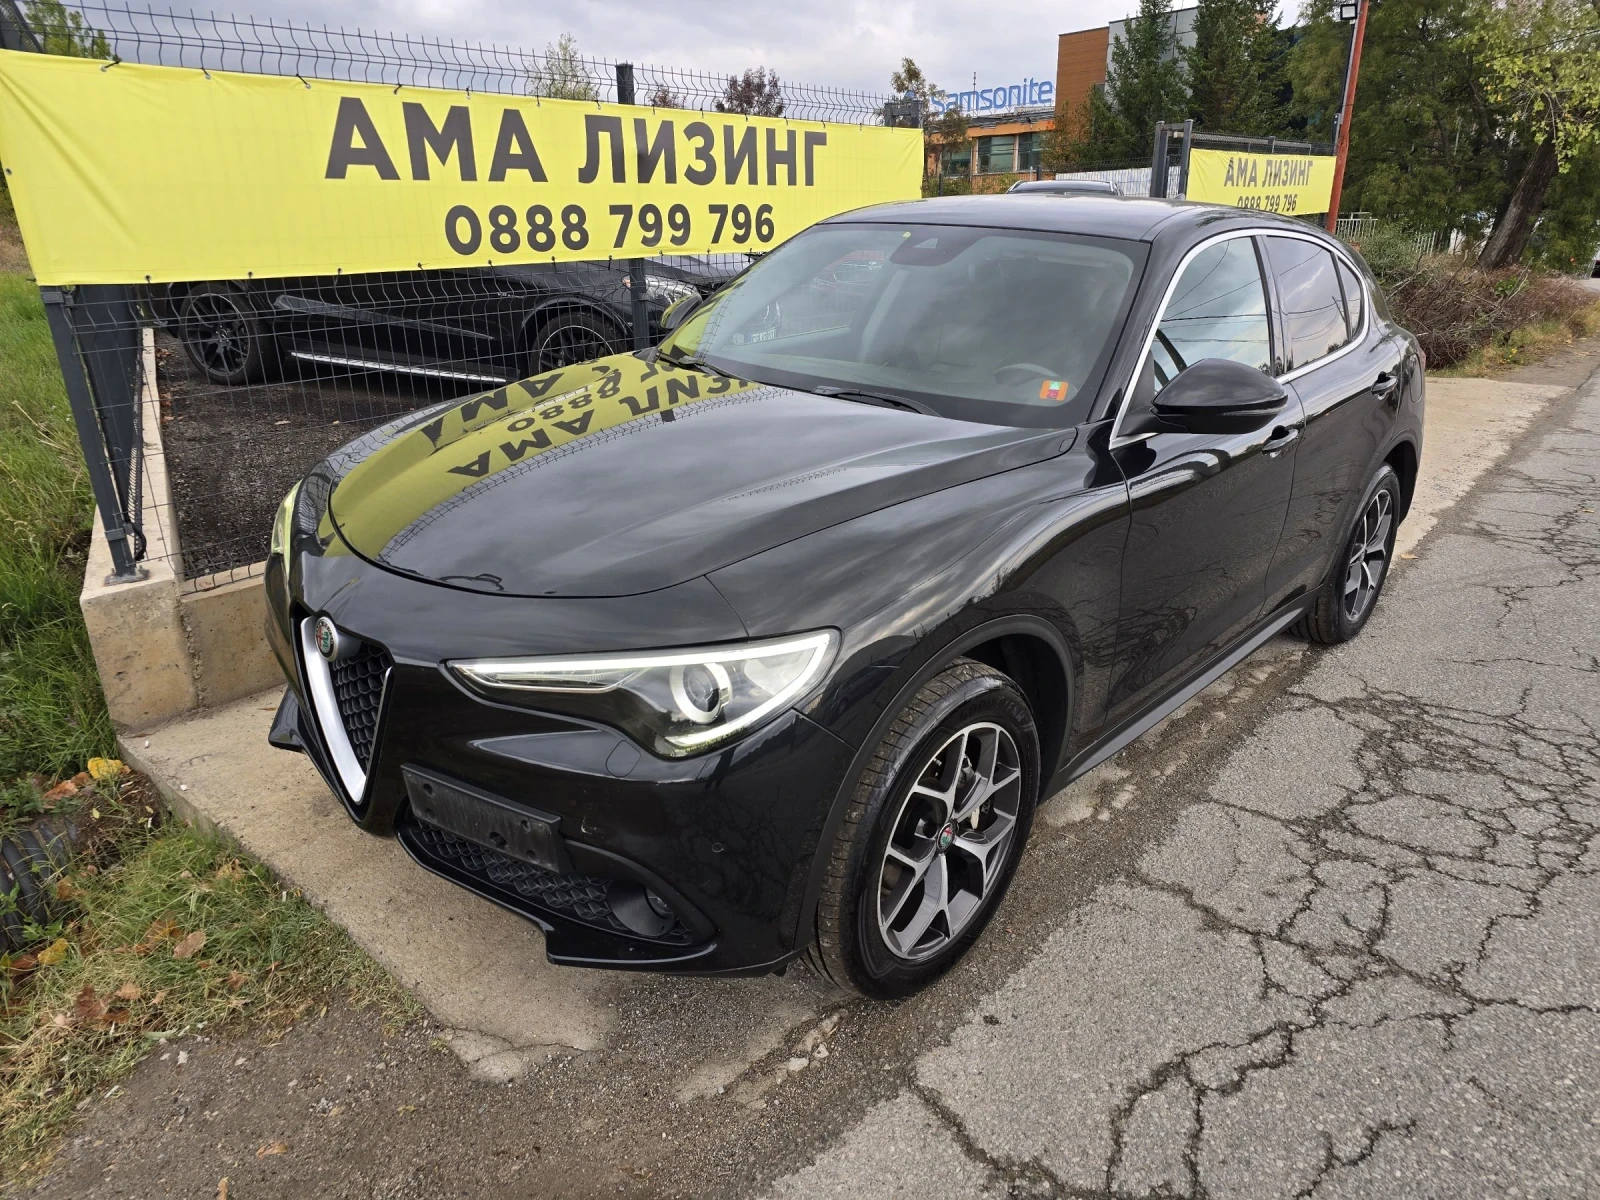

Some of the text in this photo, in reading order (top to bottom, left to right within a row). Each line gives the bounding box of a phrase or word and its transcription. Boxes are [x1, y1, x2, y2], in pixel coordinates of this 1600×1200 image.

[931, 78, 1053, 115] Samsonite
[324, 96, 828, 187] АМА ЛИЗИНГ
[1224, 157, 1313, 187] АМА ЛИЗИНГ
[1265, 194, 1281, 212] 799
[1282, 194, 1298, 212] 796
[444, 203, 775, 255] 0888 799 796
